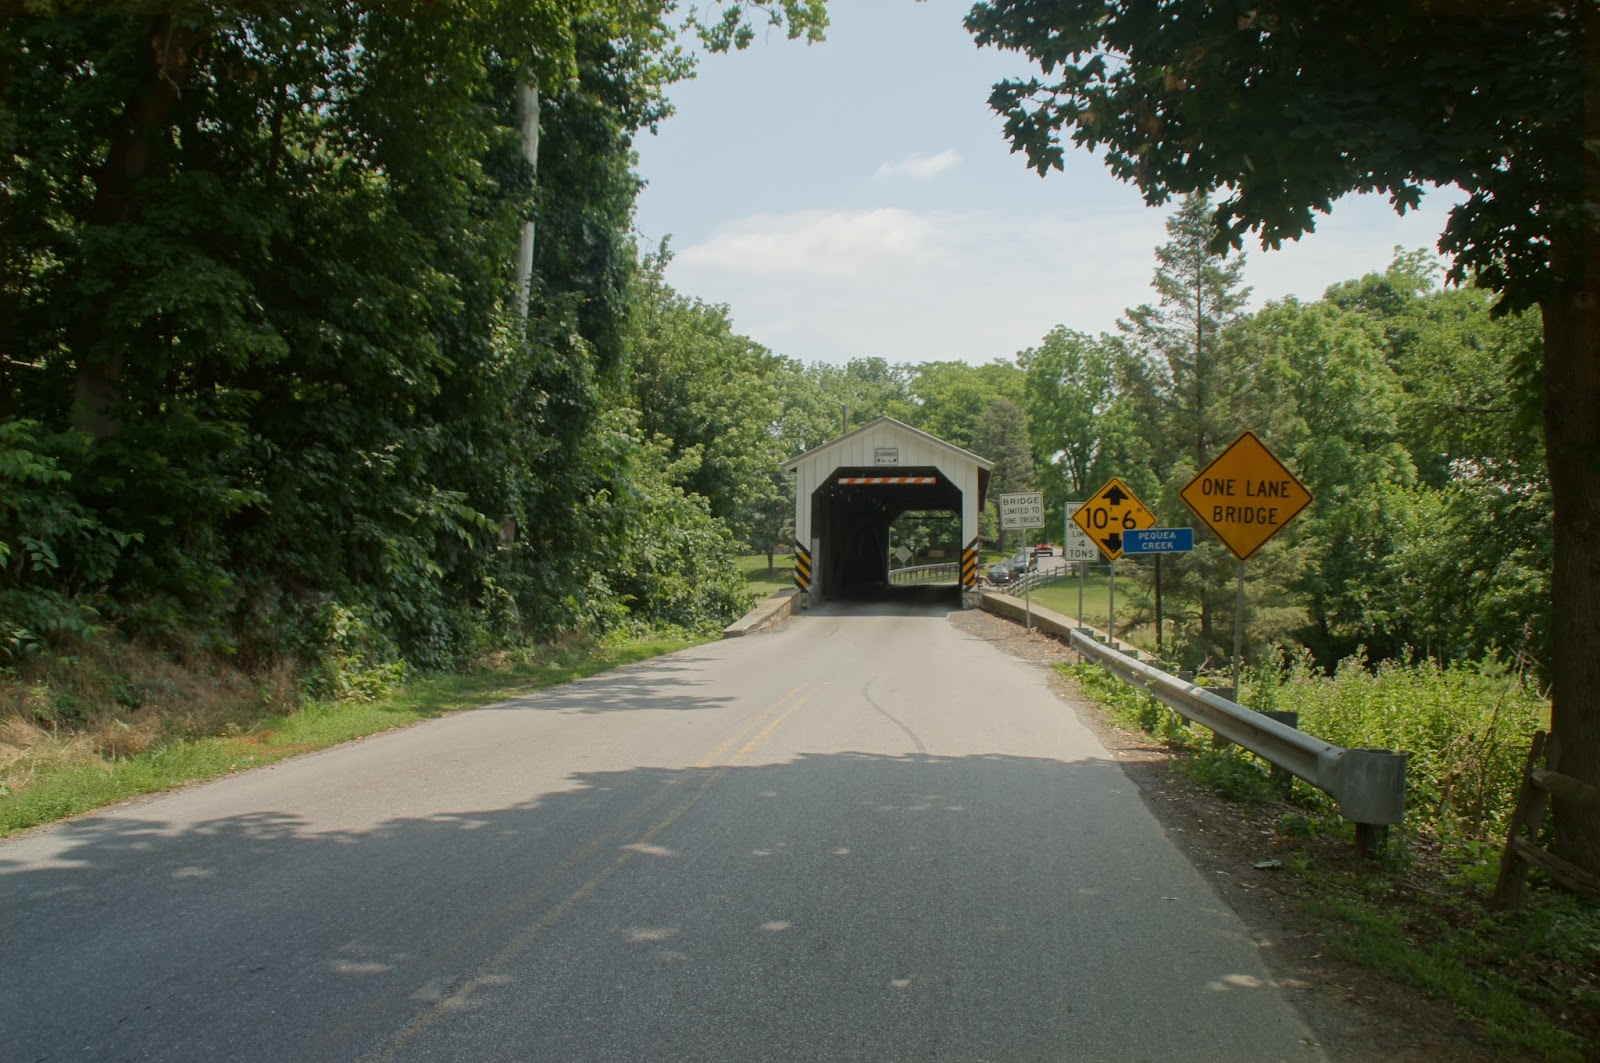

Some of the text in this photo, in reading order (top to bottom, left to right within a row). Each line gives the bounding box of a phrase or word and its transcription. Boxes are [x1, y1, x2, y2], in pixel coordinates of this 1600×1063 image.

[1202, 478, 1290, 498] ONE LANE
[1003, 496, 1040, 506] BRIDGE
[1004, 506, 1040, 515] LIMITED TO
[1213, 506, 1278, 525] BRIDGE
[1003, 516, 1041, 525] ONE TRUCK
[1138, 531, 1177, 540] PEQUEA
[1078, 539, 1086, 547] 4
[1141, 541, 1174, 550] CREEK
[1069, 549, 1094, 558] TONS
